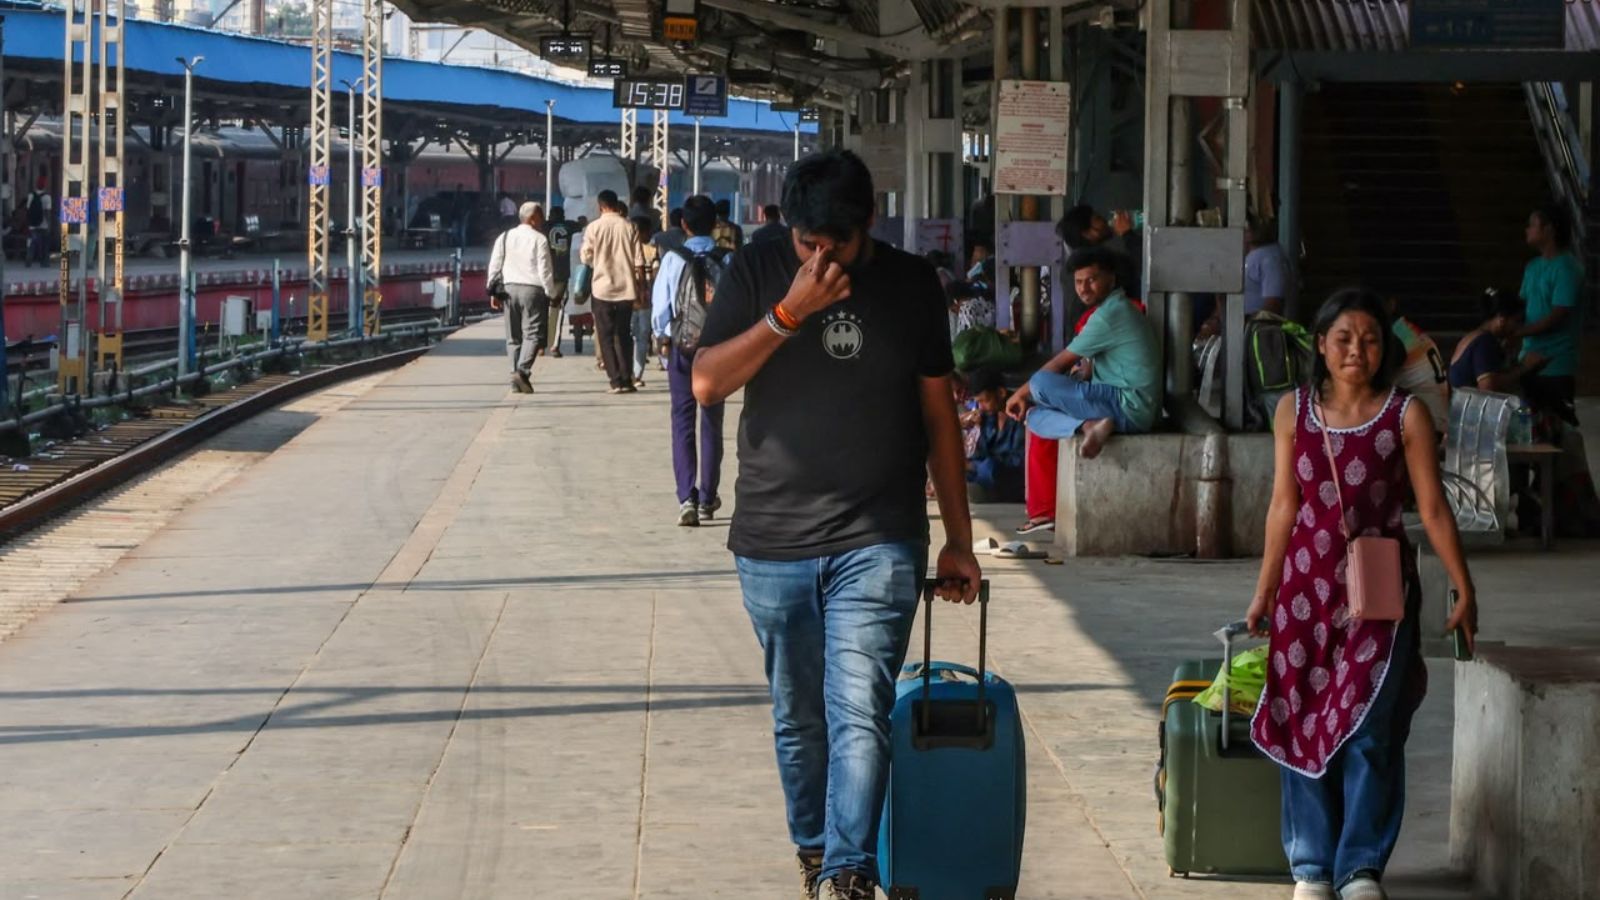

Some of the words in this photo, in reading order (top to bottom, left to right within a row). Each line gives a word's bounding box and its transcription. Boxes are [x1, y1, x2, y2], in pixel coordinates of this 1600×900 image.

[628, 82, 683, 107] 15:38
[62, 198, 88, 210] CSMT
[549, 226, 568, 251] G
